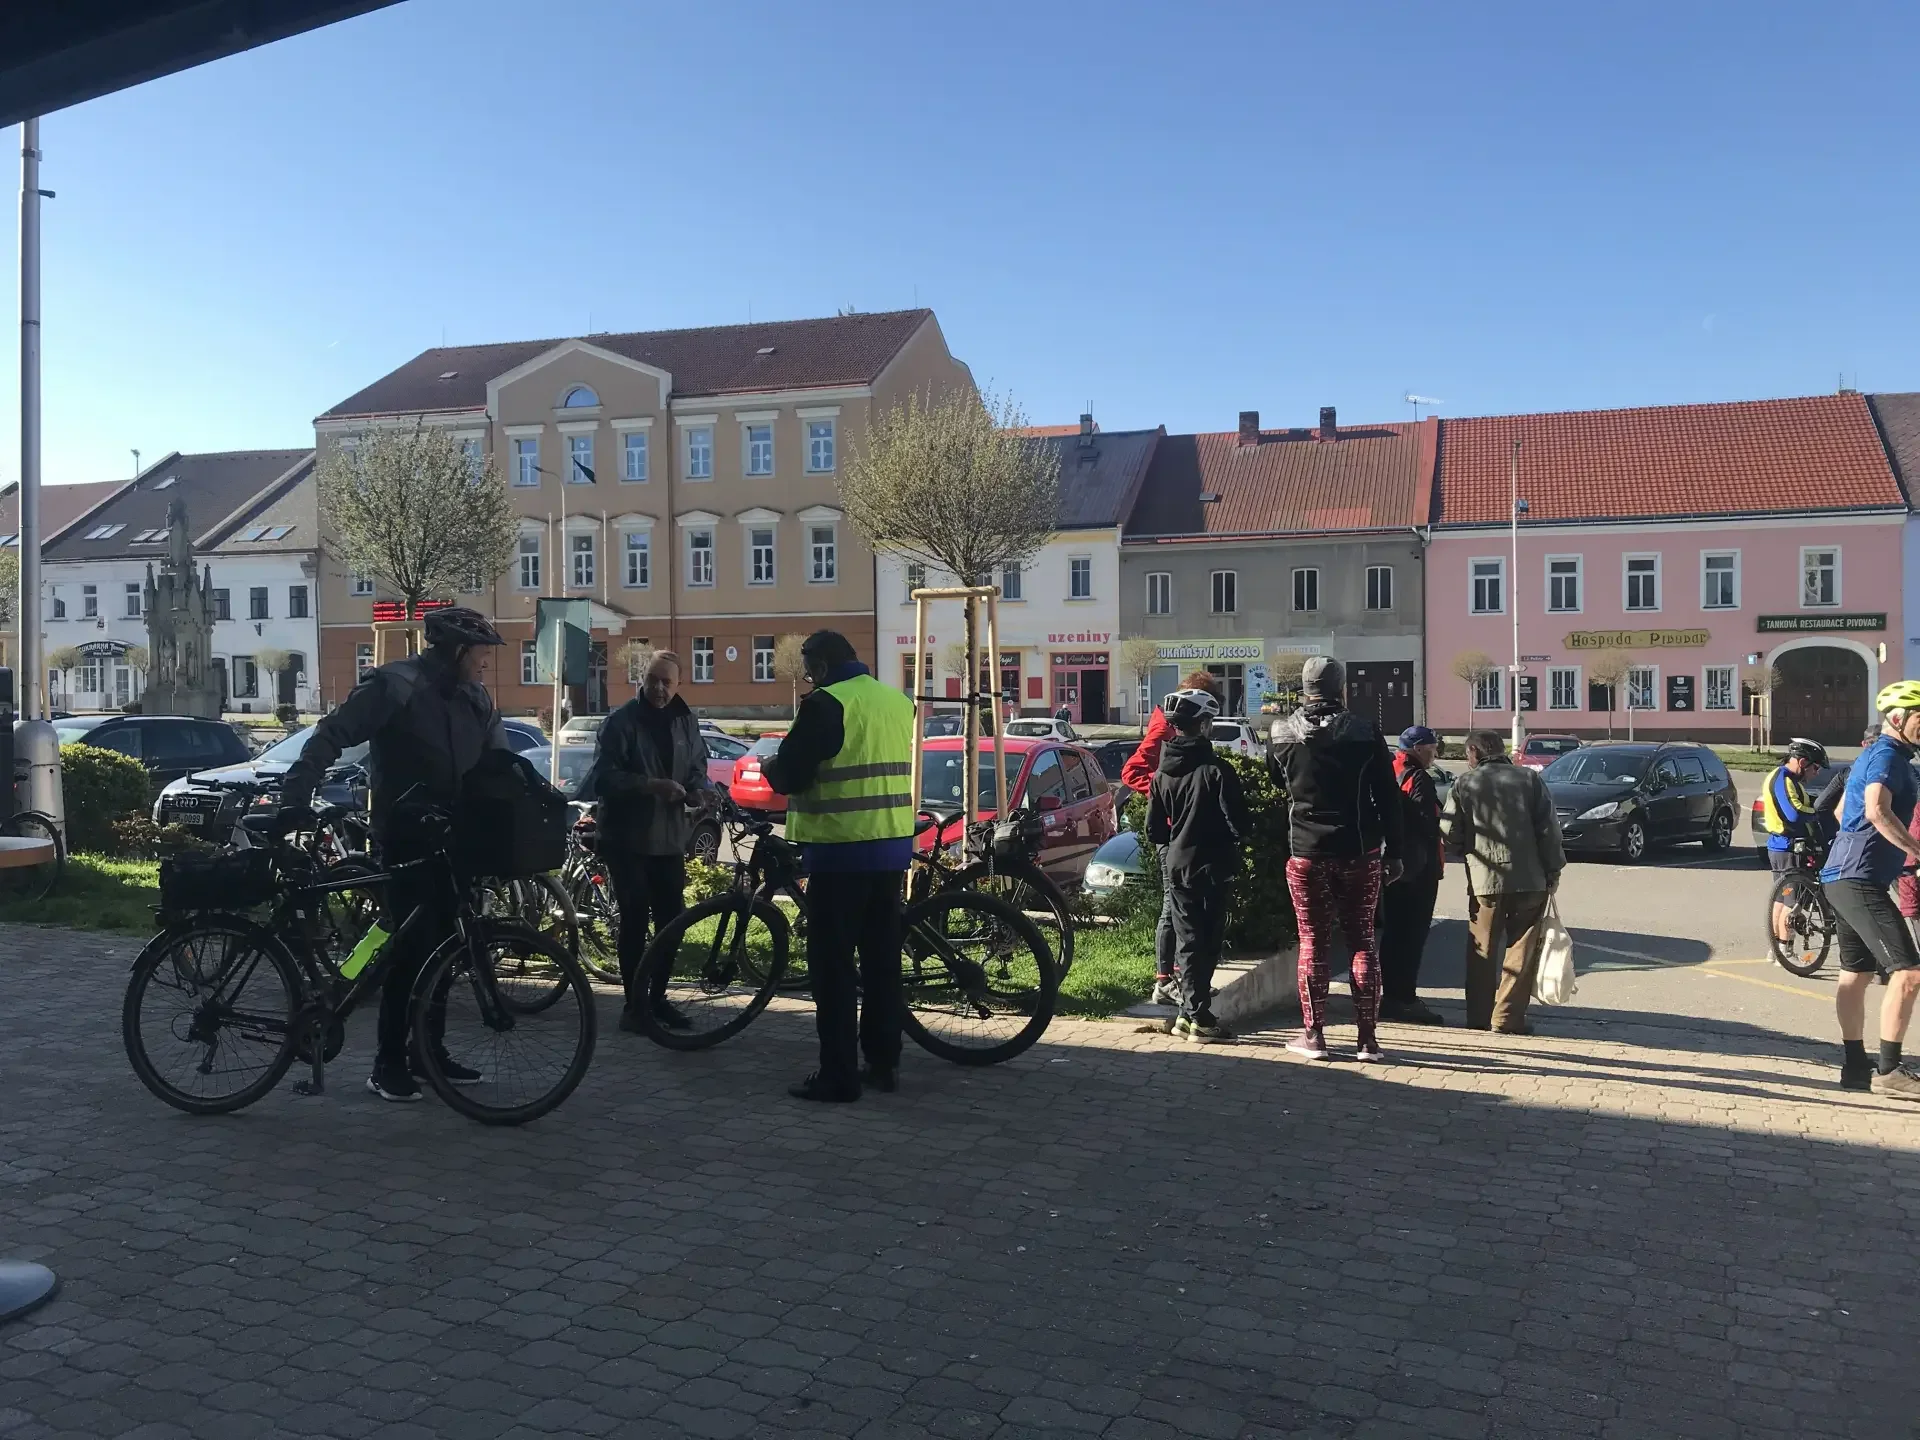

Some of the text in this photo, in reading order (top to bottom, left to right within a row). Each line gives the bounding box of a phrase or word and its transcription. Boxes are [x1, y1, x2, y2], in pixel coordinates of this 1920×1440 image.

[1766, 618, 1878, 629] TANKOVÁ RESTAURACE PIVOVAR
[896, 635, 936, 645] mao
[1048, 628, 1111, 644] uzeniny
[1571, 631, 1633, 649] Hospoda
[1217, 645, 1260, 658] PICCOLO
